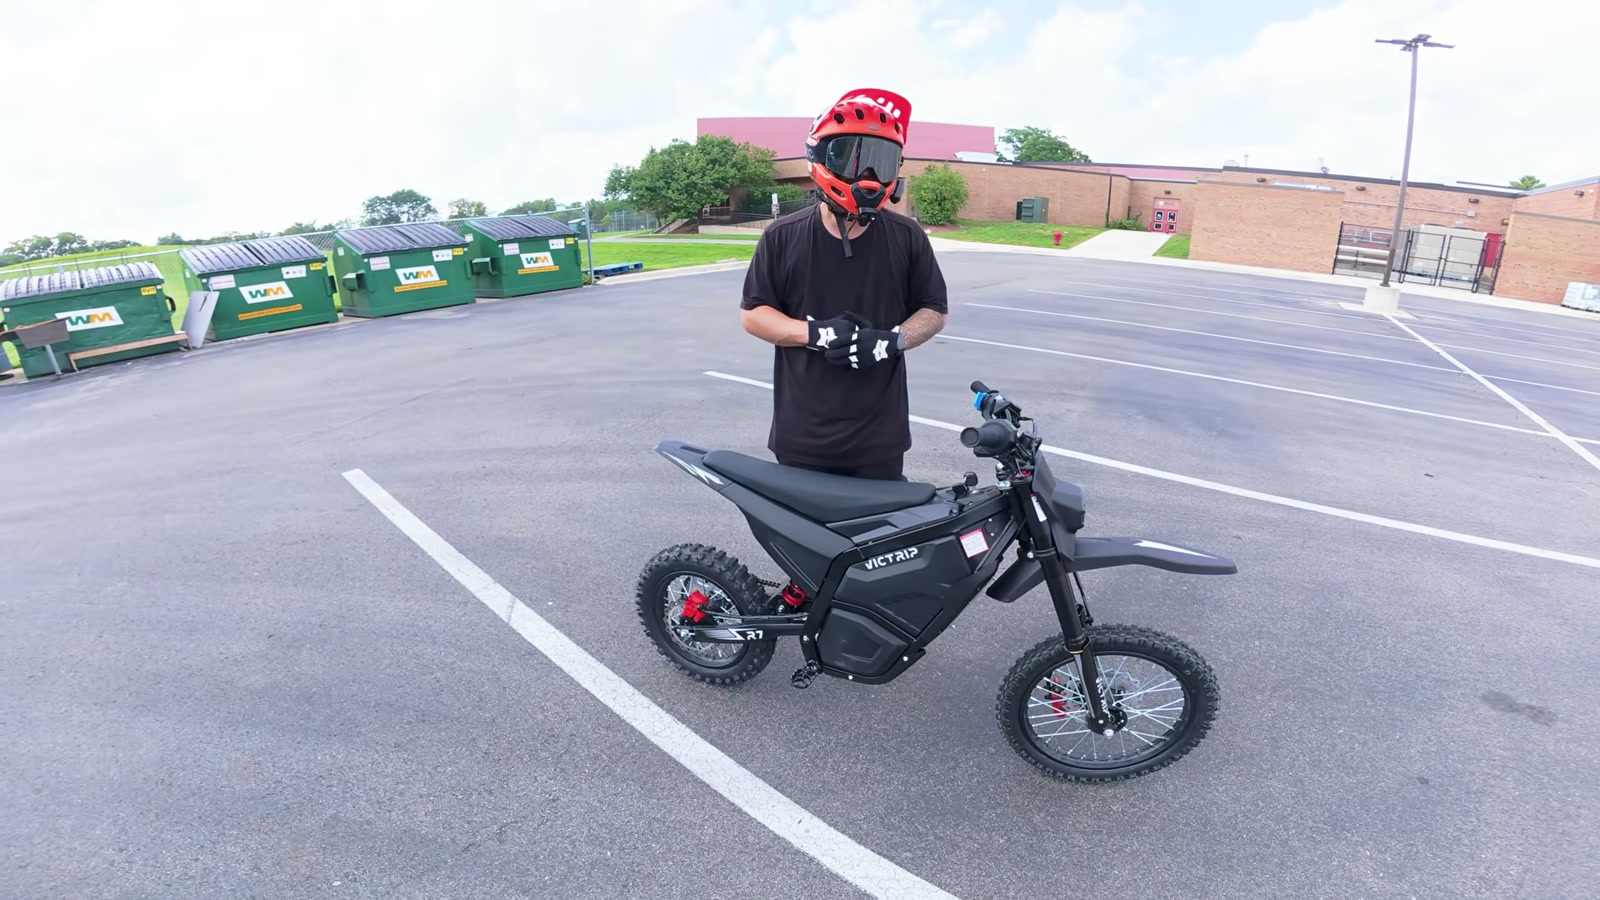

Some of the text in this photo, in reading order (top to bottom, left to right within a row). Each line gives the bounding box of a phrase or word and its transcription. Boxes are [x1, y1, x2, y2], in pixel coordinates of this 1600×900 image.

[526, 256, 549, 265] WM
[403, 269, 433, 281] WM
[248, 286, 285, 299] WM
[68, 312, 113, 326] WM
[864, 547, 919, 570] VICTRIP
[746, 630, 764, 640] R7
